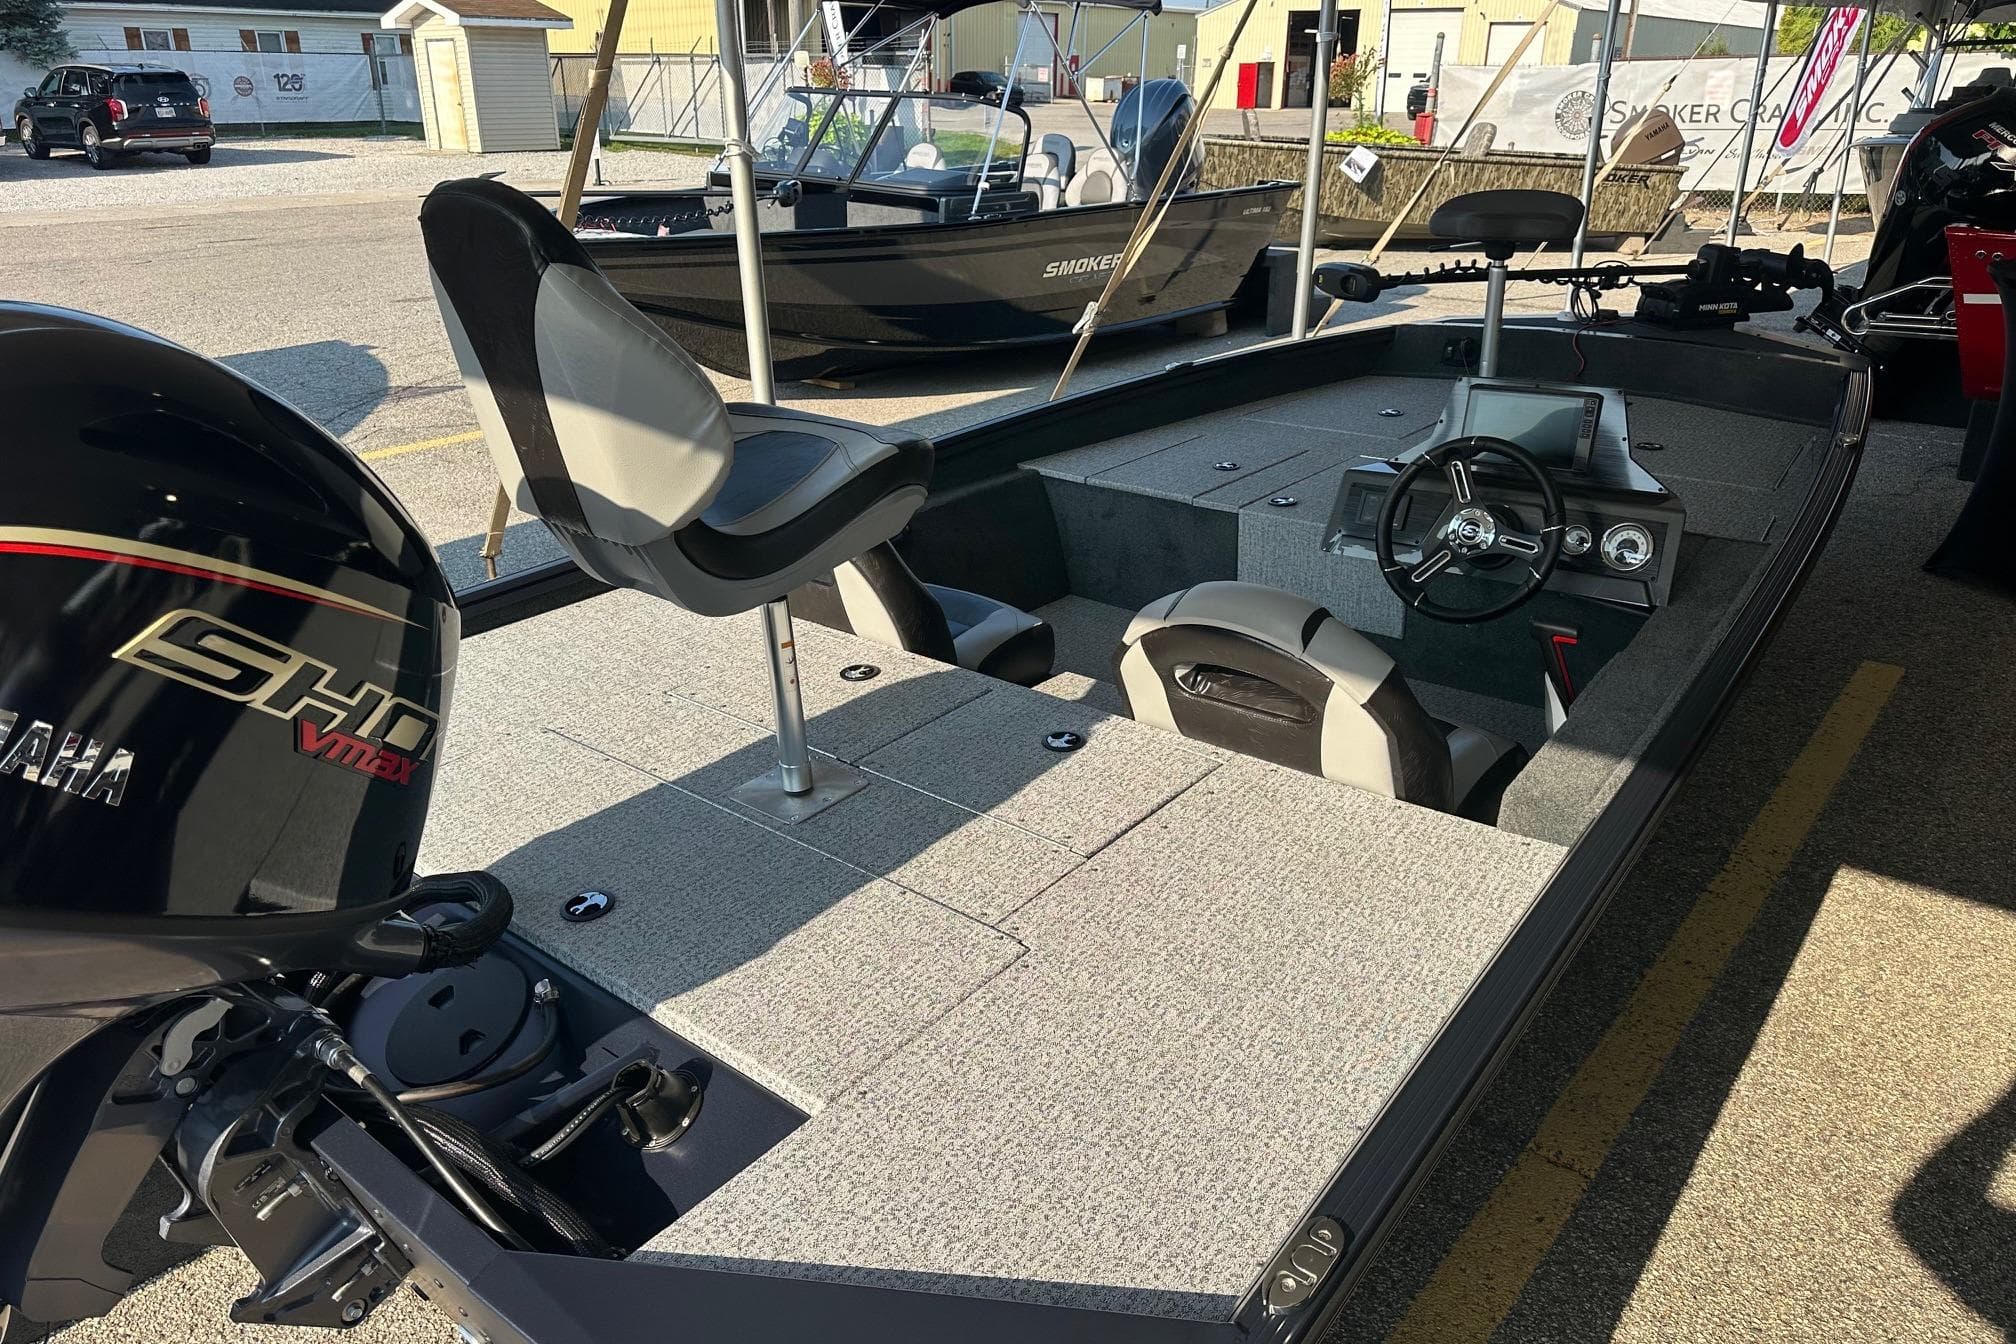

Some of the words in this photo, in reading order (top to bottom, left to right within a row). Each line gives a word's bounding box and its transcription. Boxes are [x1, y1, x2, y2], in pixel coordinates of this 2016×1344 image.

[1795, 8, 1848, 129] SMOK
[1730, 98, 1783, 123] CRA
[1644, 121, 1670, 141] YAMAHA
[1605, 173, 1650, 190] OKER
[1043, 253, 1123, 278] SMOKER
[1699, 303, 1718, 311] MINN
[1719, 302, 1738, 310] KOTA
[111, 608, 440, 762] SHO
